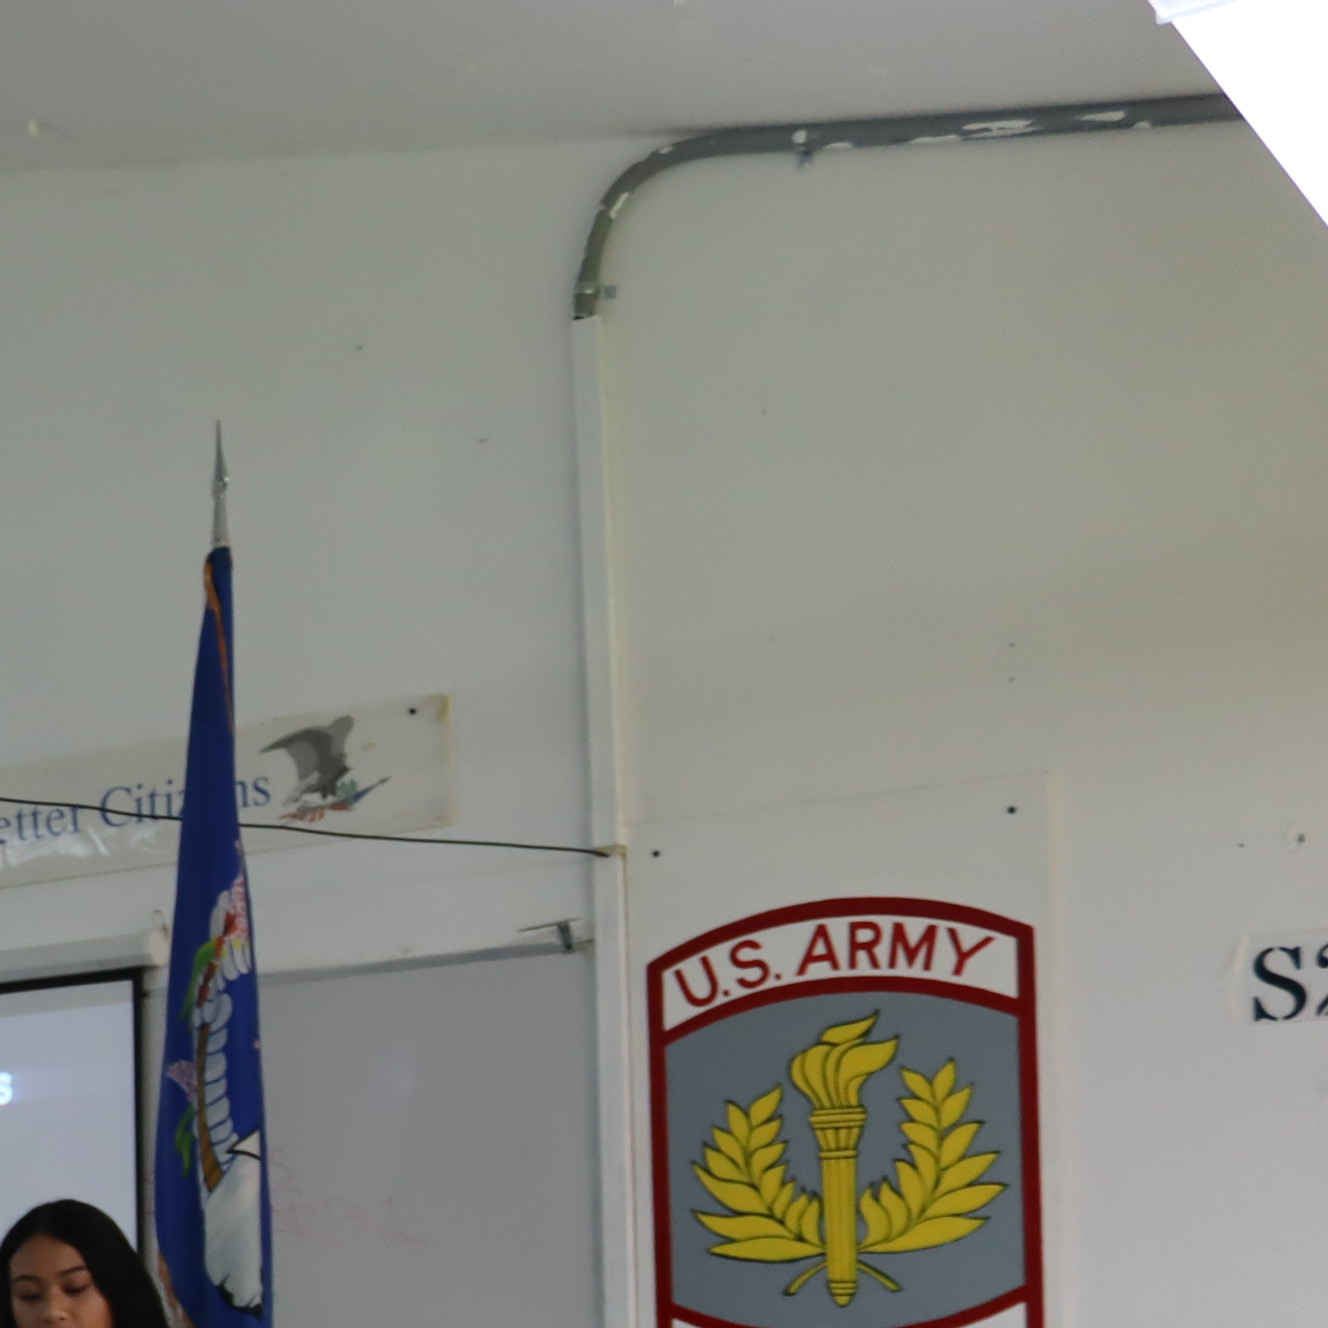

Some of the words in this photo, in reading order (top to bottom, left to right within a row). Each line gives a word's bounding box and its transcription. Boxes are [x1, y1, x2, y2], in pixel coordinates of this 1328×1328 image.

[99, 776, 271, 829] Citins
[674, 939, 782, 1009] U.S.
[795, 920, 996, 977] ARMY
